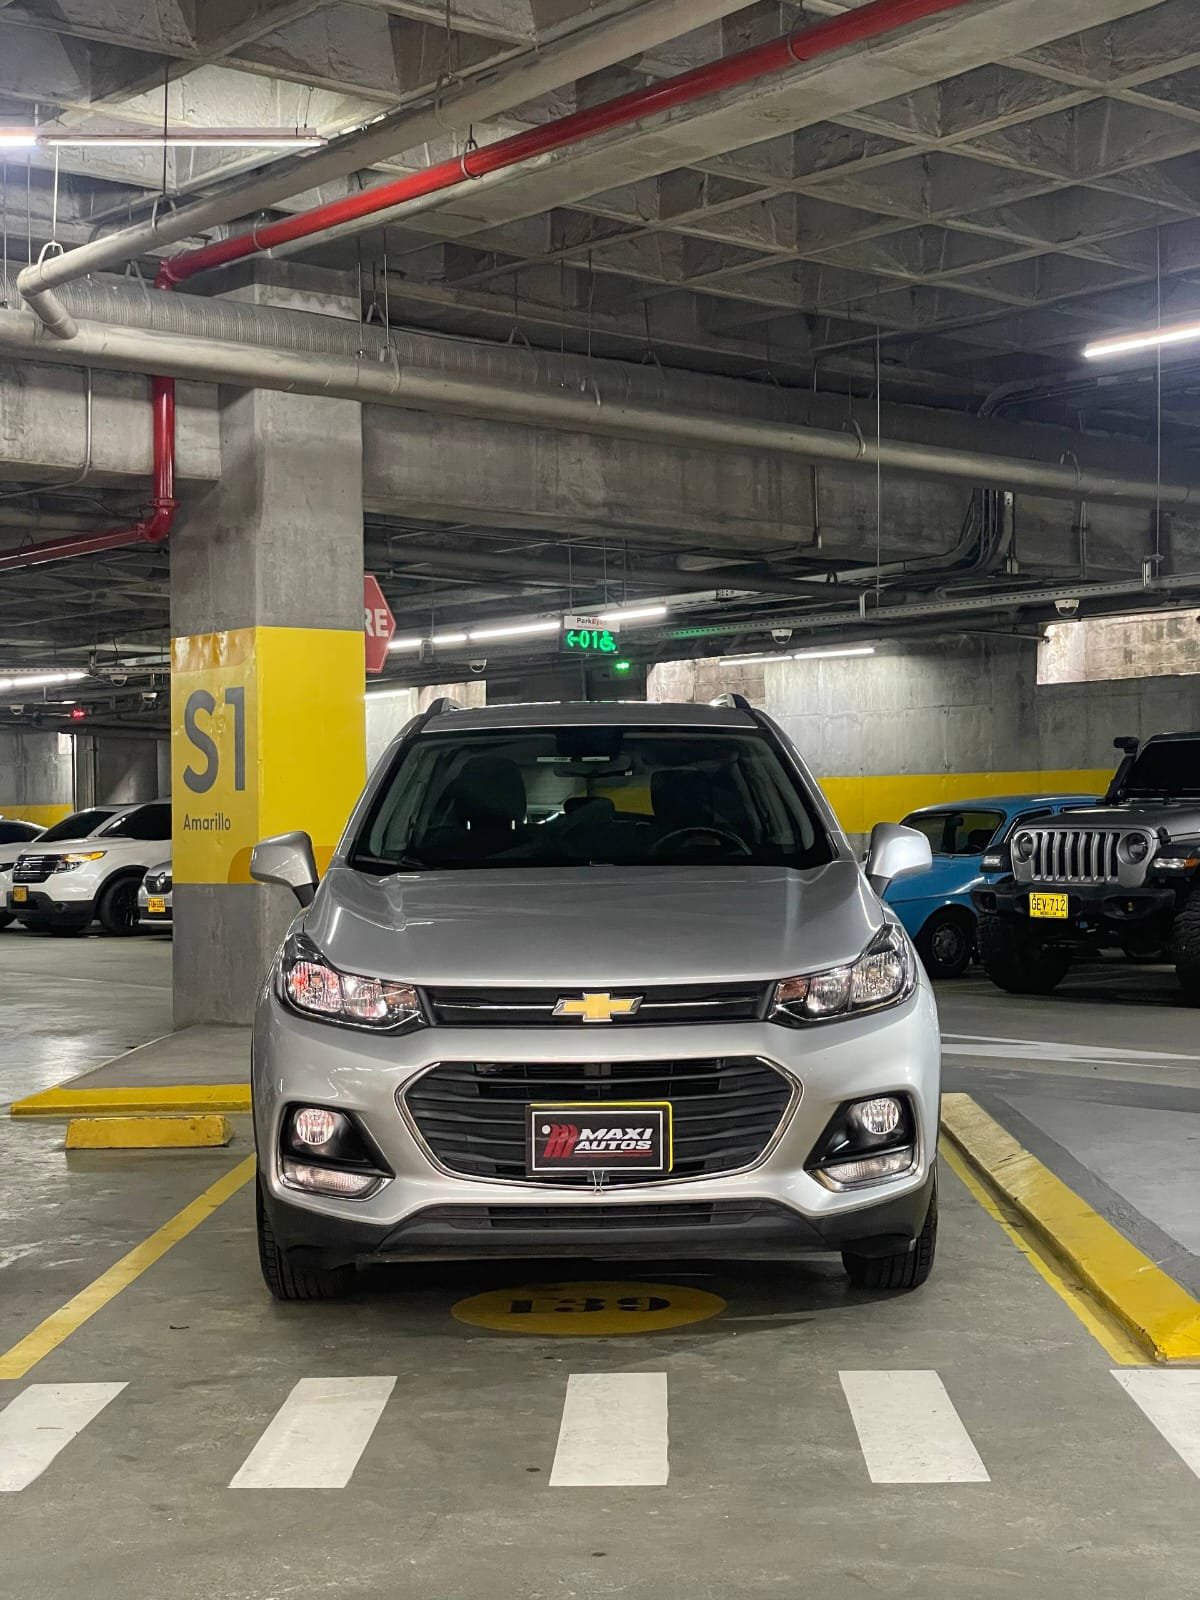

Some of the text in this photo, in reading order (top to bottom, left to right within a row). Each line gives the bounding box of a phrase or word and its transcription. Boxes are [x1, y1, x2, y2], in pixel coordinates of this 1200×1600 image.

[183, 686, 246, 794] S1
[183, 813, 231, 831] Amarillo
[579, 1128, 653, 1140] MAXI
[575, 1140, 652, 1150] AUTOS
